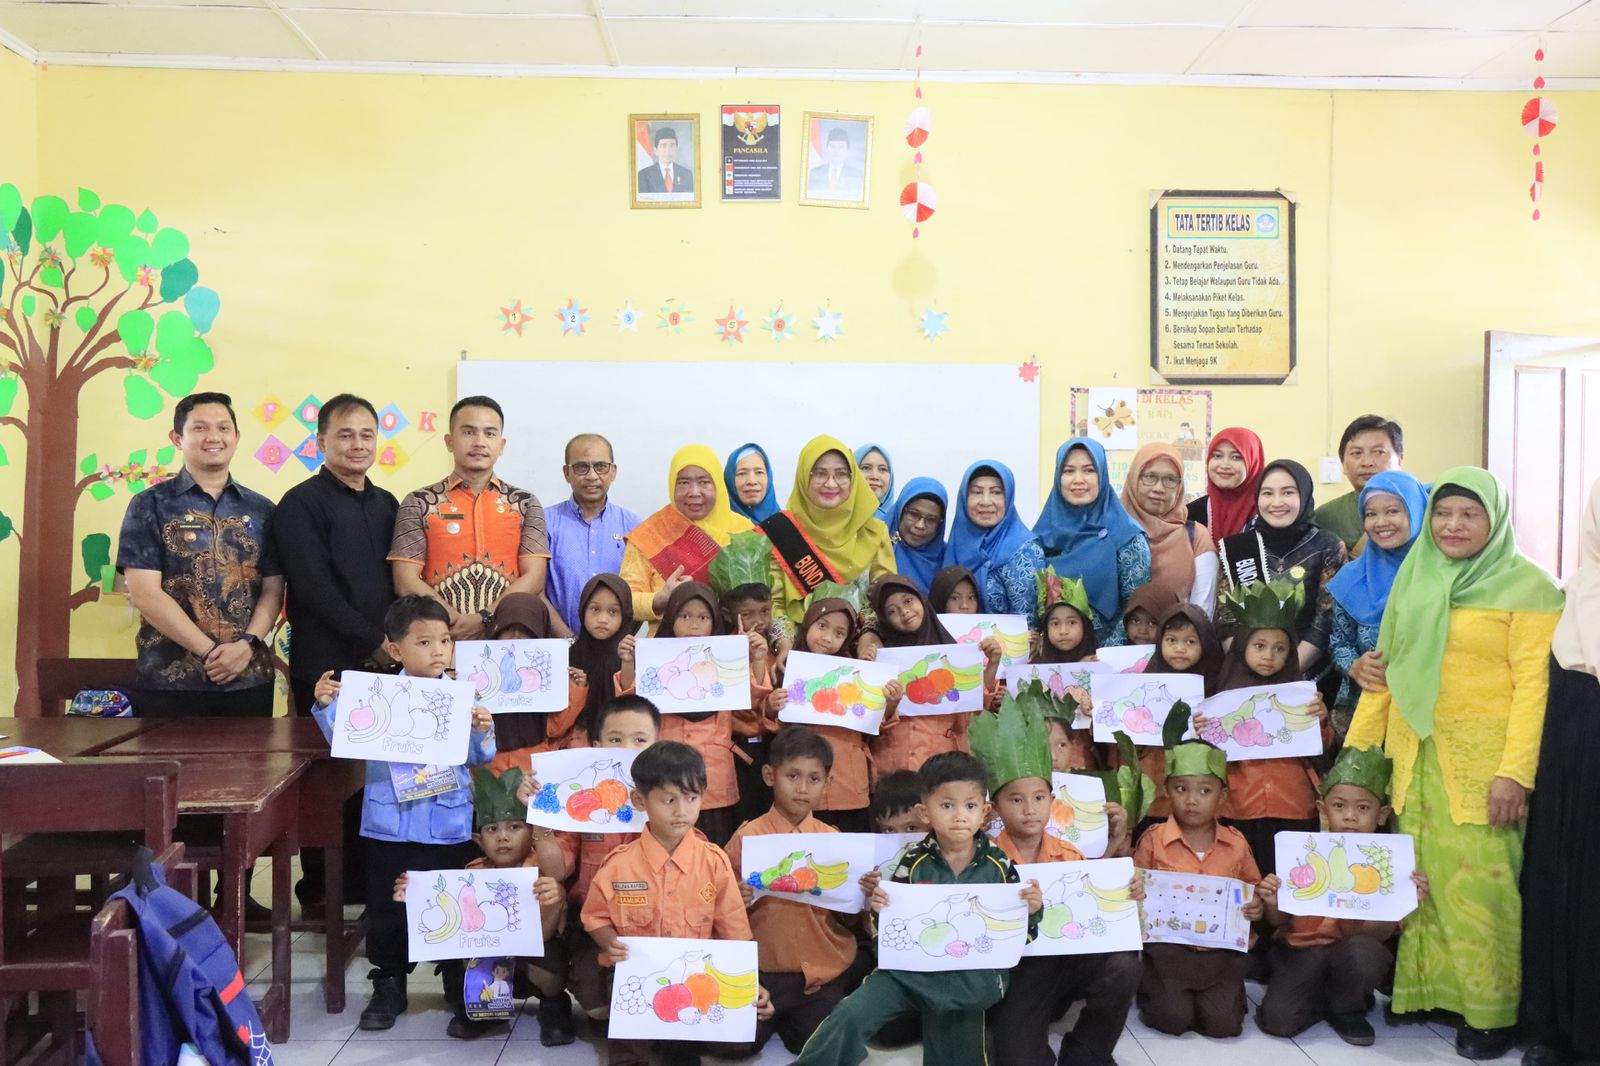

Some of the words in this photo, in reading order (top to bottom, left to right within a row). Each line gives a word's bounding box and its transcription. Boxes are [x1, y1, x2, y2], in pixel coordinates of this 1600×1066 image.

[1175, 213, 1194, 231] TATA
[1196, 213, 1223, 231] TERTIB
[1225, 213, 1251, 231] KELAS
[1165, 244, 1171, 253] 1.
[1172, 244, 1191, 255] Datang
[1193, 244, 1208, 255] Tepat
[1209, 244, 1228, 254] Waktu.
[1165, 260, 1171, 269] 2.
[1172, 260, 1212, 271] Mendengarkan
[1213, 260, 1243, 271] Penjelasan
[1244, 260, 1259, 269] Guru.
[1165, 276, 1171, 285] 3.
[1173, 276, 1188, 287] Tetap
[1190, 276, 1209, 287] Belajar
[1210, 276, 1236, 287] Walaupun
[1237, 276, 1251, 286] Guru
[1252, 276, 1267, 286] Tidak
[1268, 277, 1281, 286] Ada.
[1165, 292, 1171, 301] 4.
[1173, 292, 1211, 302] Melaksanakan
[1212, 292, 1227, 302] Piket
[1228, 293, 1245, 302] Kelas.
[1165, 308, 1171, 317] 5.
[1173, 308, 1208, 319] Mengerjakan
[1209, 308, 1225, 319] Tugas
[1227, 308, 1240, 319] Yang
[1241, 308, 1267, 318] Diberikan
[1268, 308, 1283, 318] Guru.
[1165, 324, 1171, 333] 6.
[1173, 324, 1197, 335] Bersikap
[1198, 324, 1215, 335] Sopan
[1216, 324, 1236, 334] Santun
[1237, 324, 1262, 335] Terhadap
[1173, 340, 1194, 349] Sesama
[1196, 340, 1214, 349] Teman
[1215, 340, 1239, 349] Sekolah.
[1165, 356, 1172, 365] 7.
[1173, 356, 1184, 365] Ikut
[1185, 356, 1208, 367] Menjaga
[1209, 356, 1218, 365] 9K
[1155, 394, 1194, 405] KELAS
[97, 693, 120, 702] TAYO
[460, 934, 502, 949] Fruits
